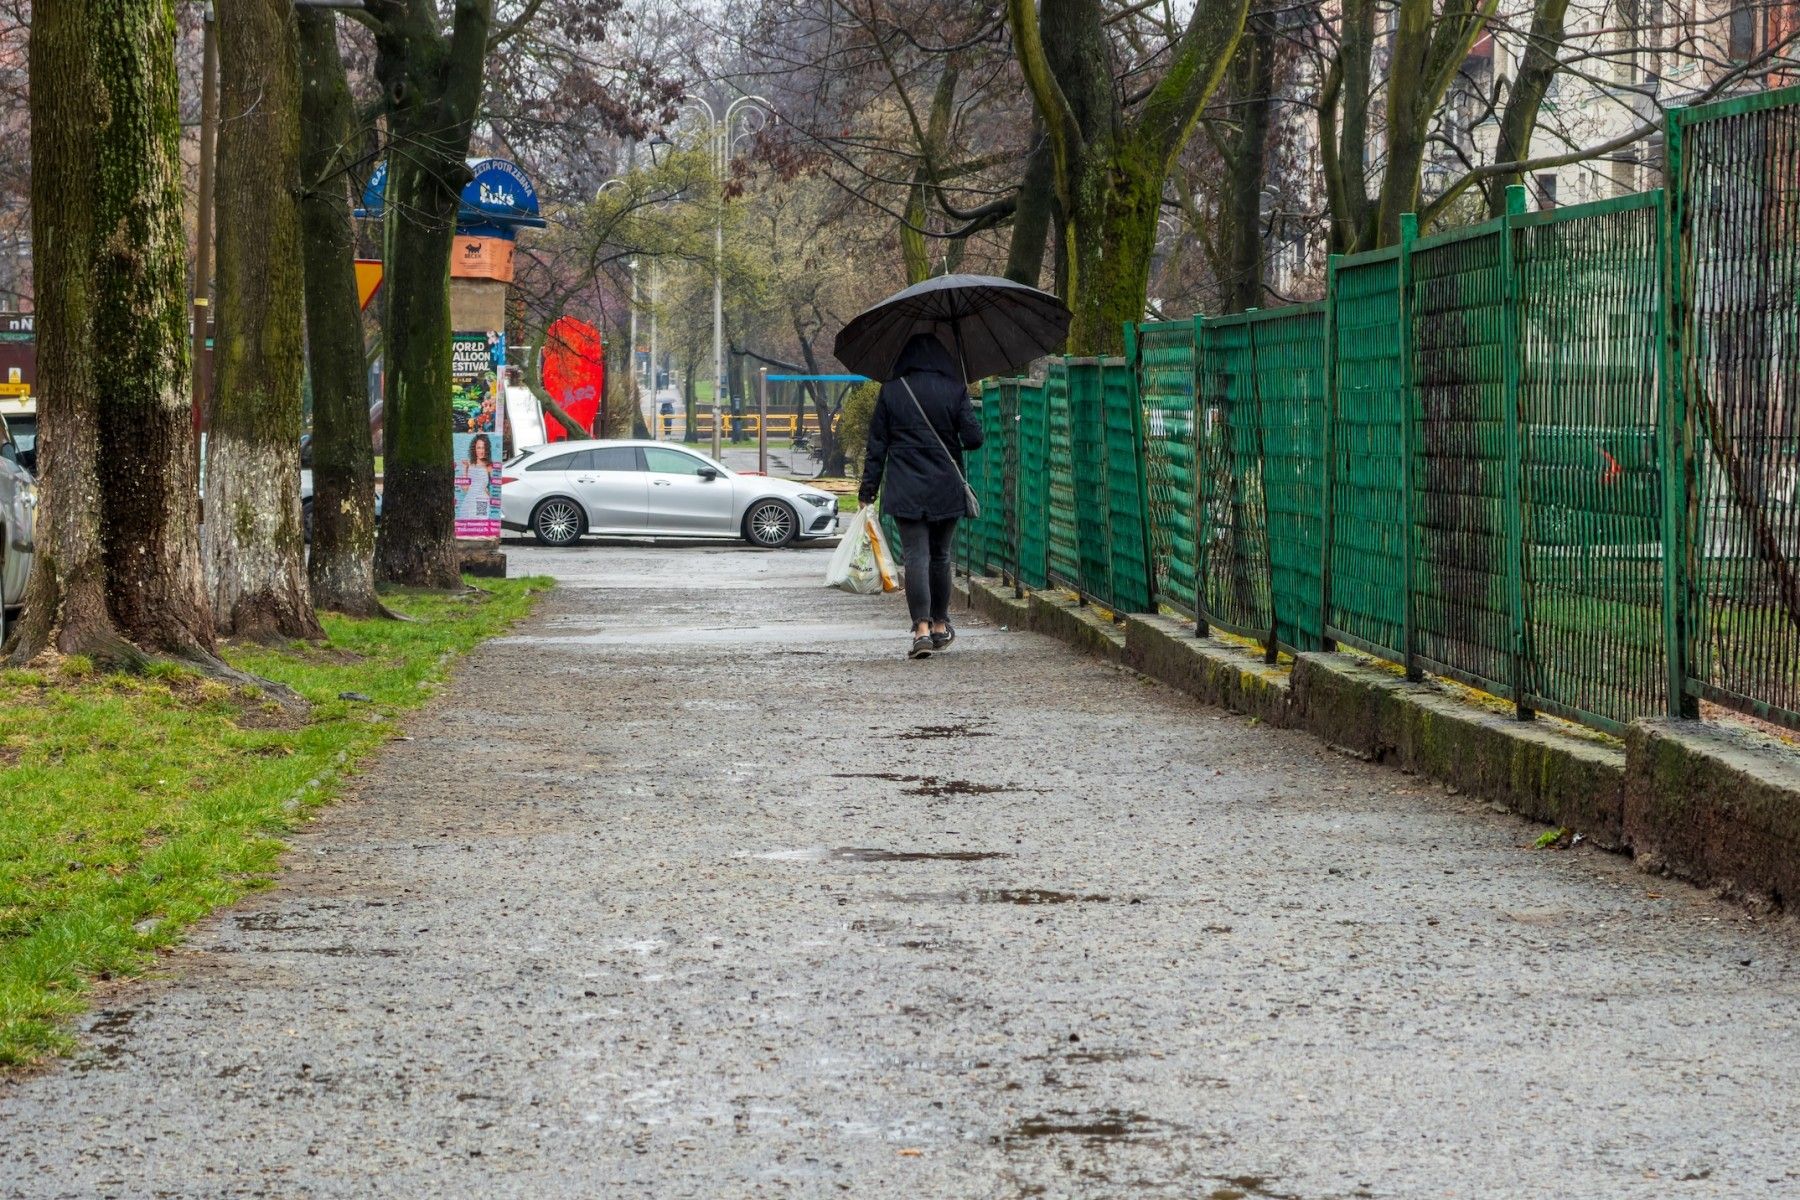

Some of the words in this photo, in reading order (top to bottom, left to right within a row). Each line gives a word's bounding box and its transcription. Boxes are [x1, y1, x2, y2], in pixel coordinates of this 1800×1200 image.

[492, 160, 533, 198] POTRZEBNA
[452, 352, 491, 361] ALLOON
[452, 361, 490, 371] ESTIVAL
